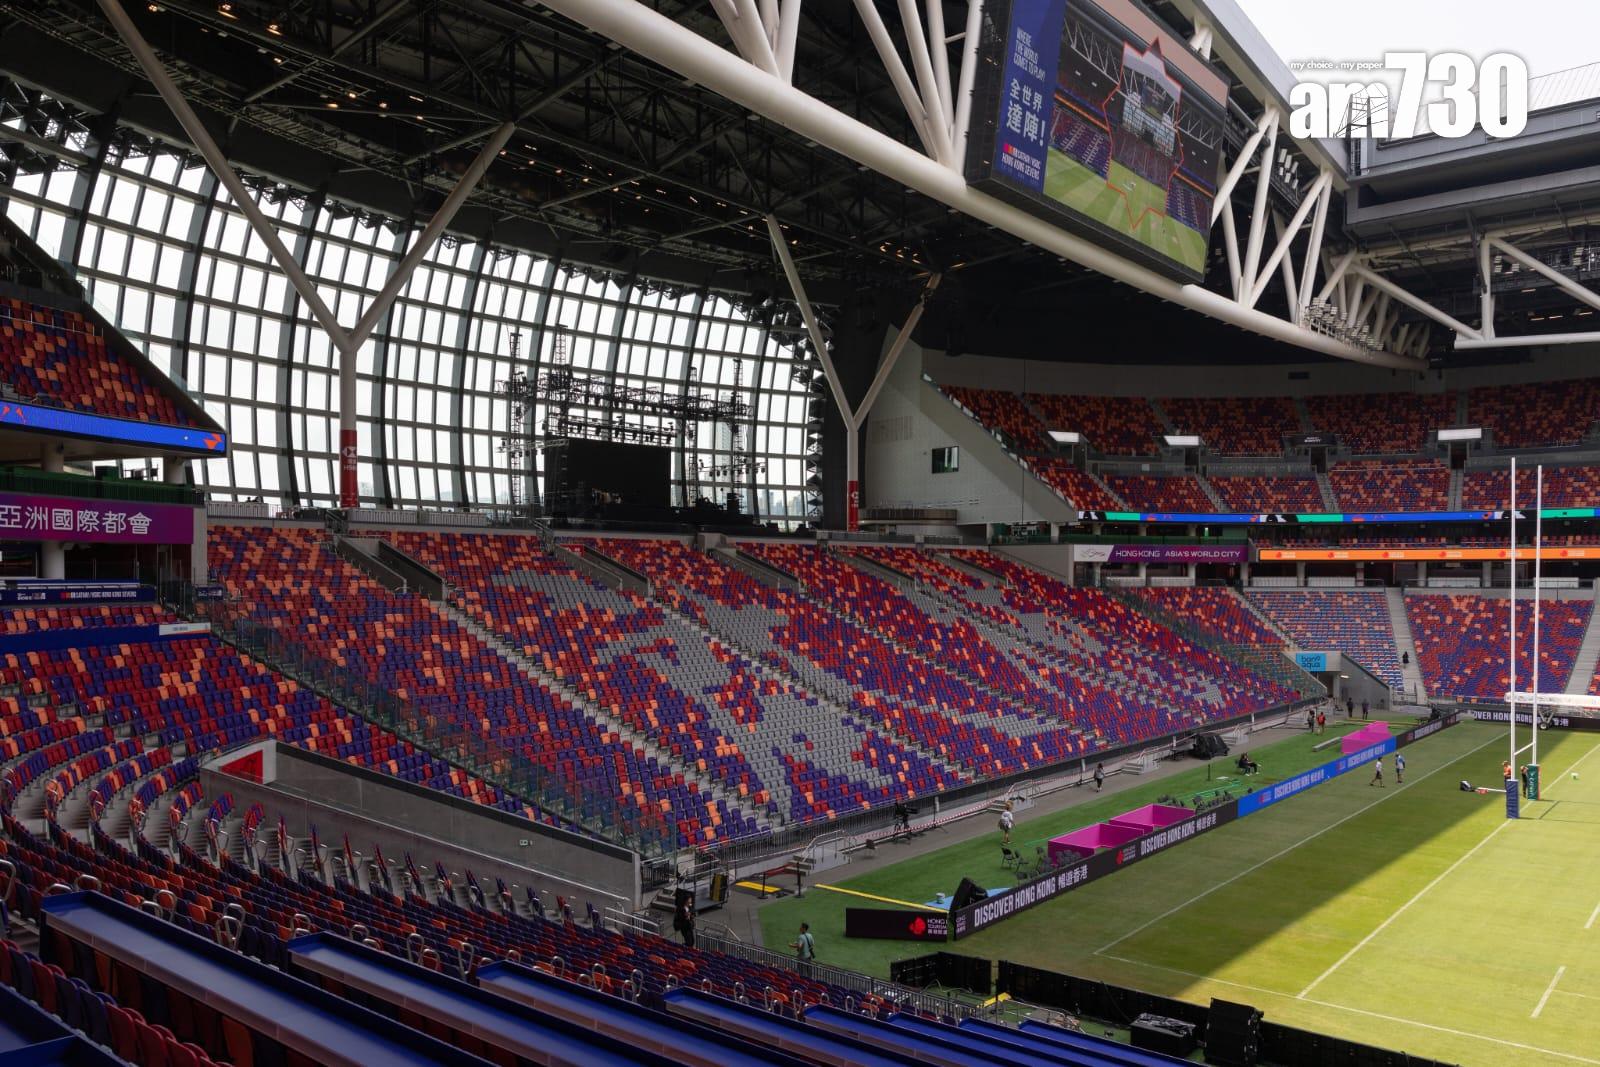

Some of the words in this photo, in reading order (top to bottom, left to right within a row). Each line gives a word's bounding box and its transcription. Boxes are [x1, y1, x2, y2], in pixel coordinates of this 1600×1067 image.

[1010, 78, 1043, 113] 全世界
[0, 504, 153, 535] 亞洲國際都會
[1164, 550, 1190, 558] ASIA'S
[1492, 712, 1512, 721] HON
[974, 894, 1014, 928] DISCOVER
[1015, 885, 1035, 910] HONG
[1036, 877, 1056, 900] KONG
